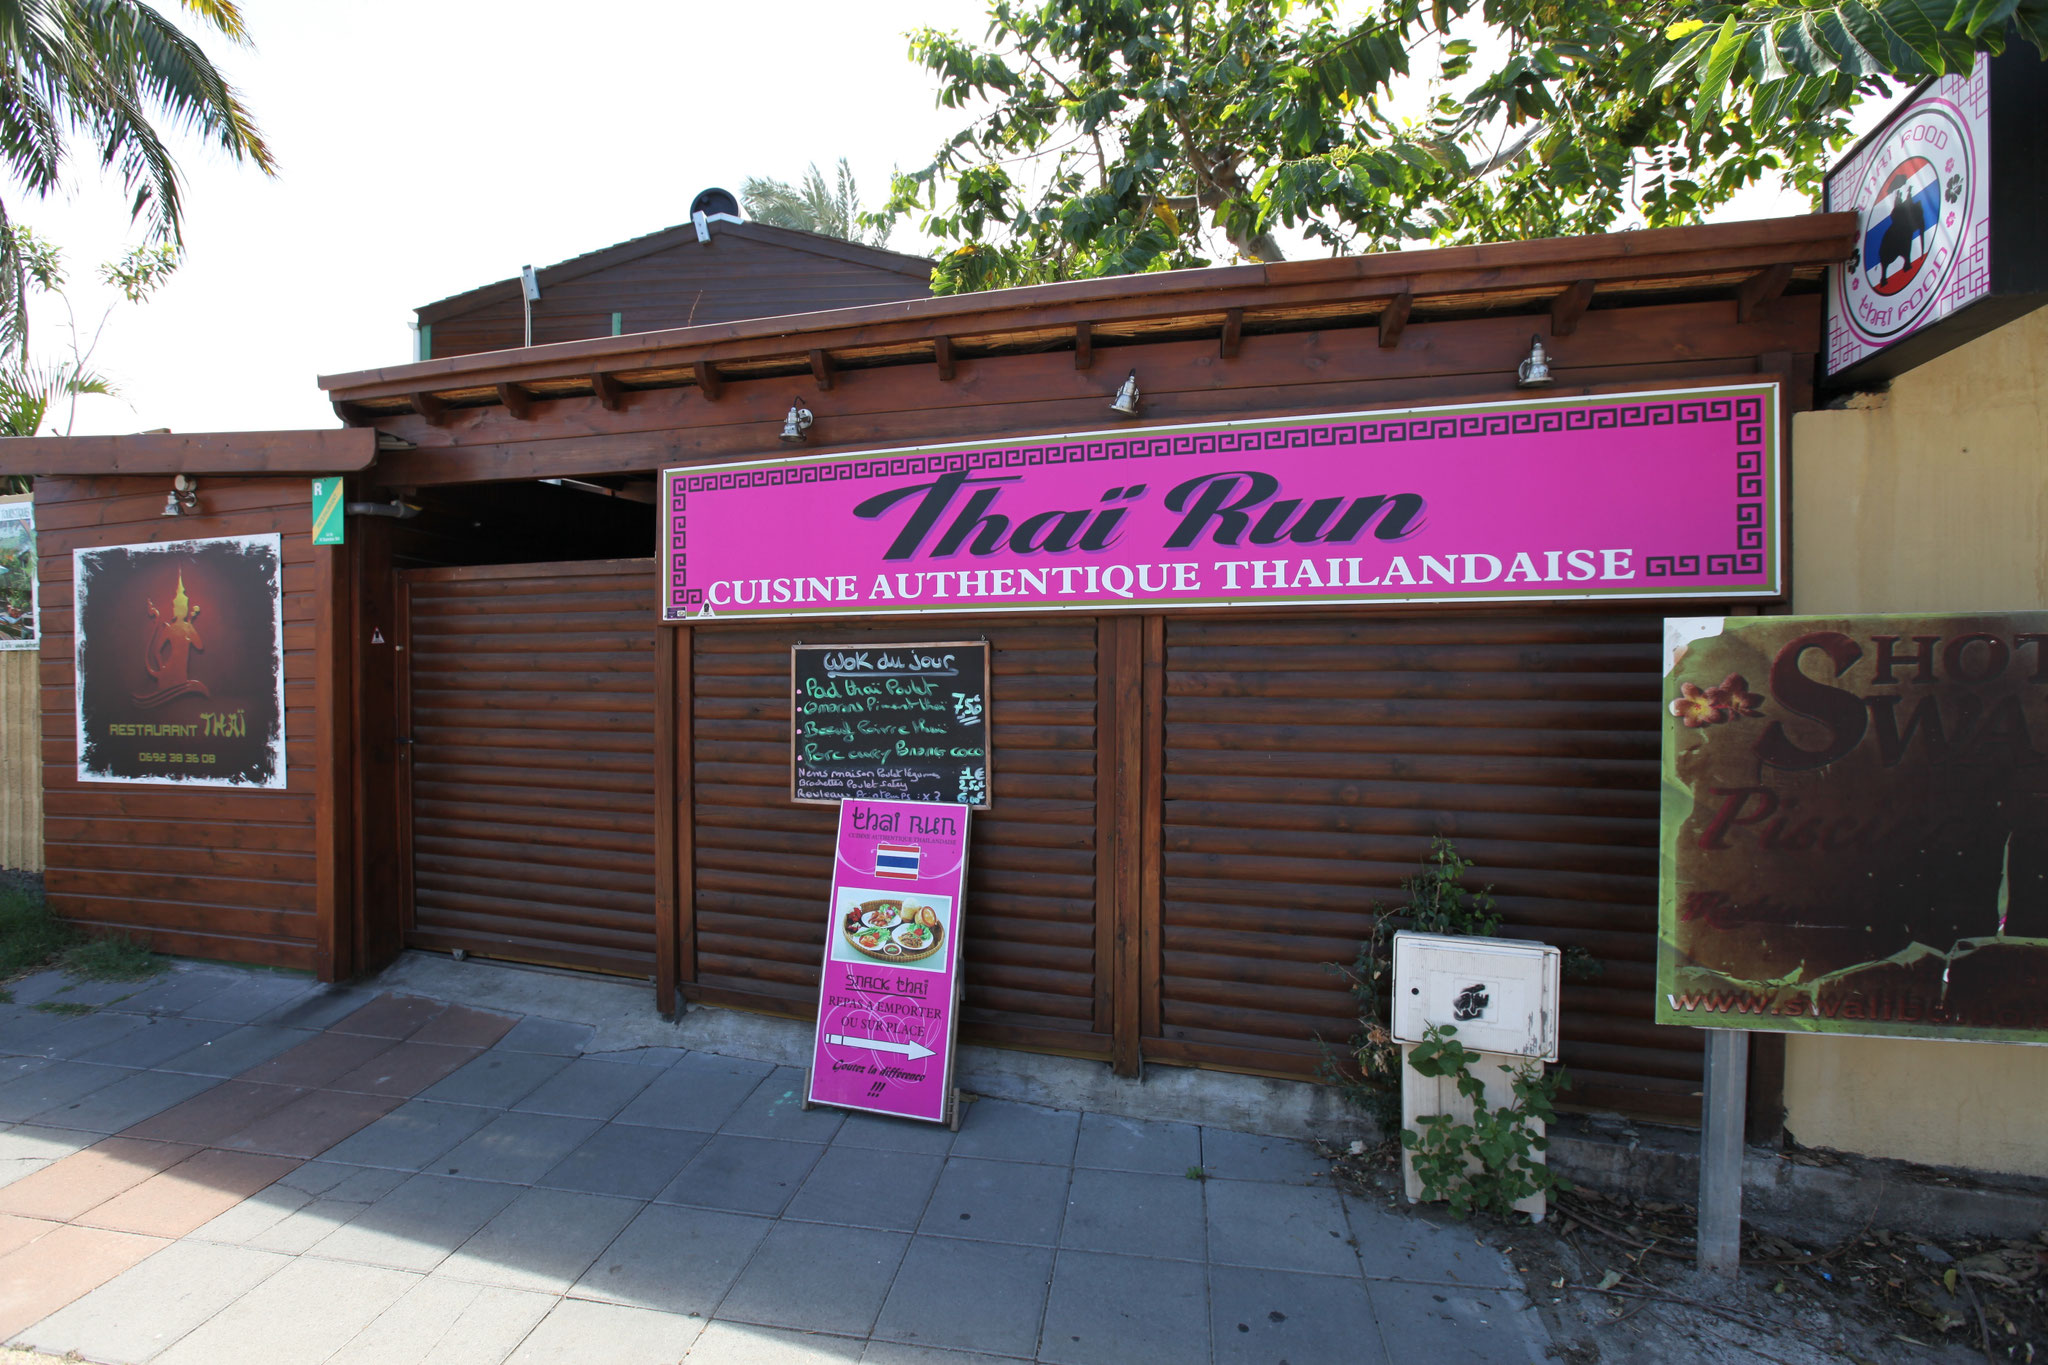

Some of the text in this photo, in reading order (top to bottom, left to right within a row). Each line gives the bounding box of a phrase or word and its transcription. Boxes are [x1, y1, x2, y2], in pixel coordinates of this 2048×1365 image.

[313, 482, 322, 496] R
[1163, 470, 1427, 551] Run
[708, 549, 1636, 605] CUISINE AUTHENTIQUE THAILANDAISE
[877, 651, 905, 671] du
[909, 650, 955, 671] jour
[806, 677, 842, 699] Pad
[886, 676, 939, 696] Poulet
[109, 723, 198, 737] RESTAURANT
[139, 752, 166, 762] 0692
[201, 754, 216, 764] 08
[804, 743, 845, 762] Porc
[828, 995, 863, 1010] REPAS
[878, 1001, 942, 1019] EMPORTER
[841, 1016, 925, 1037] OU SUR PLACE
[868, 1064, 877, 1075] la
